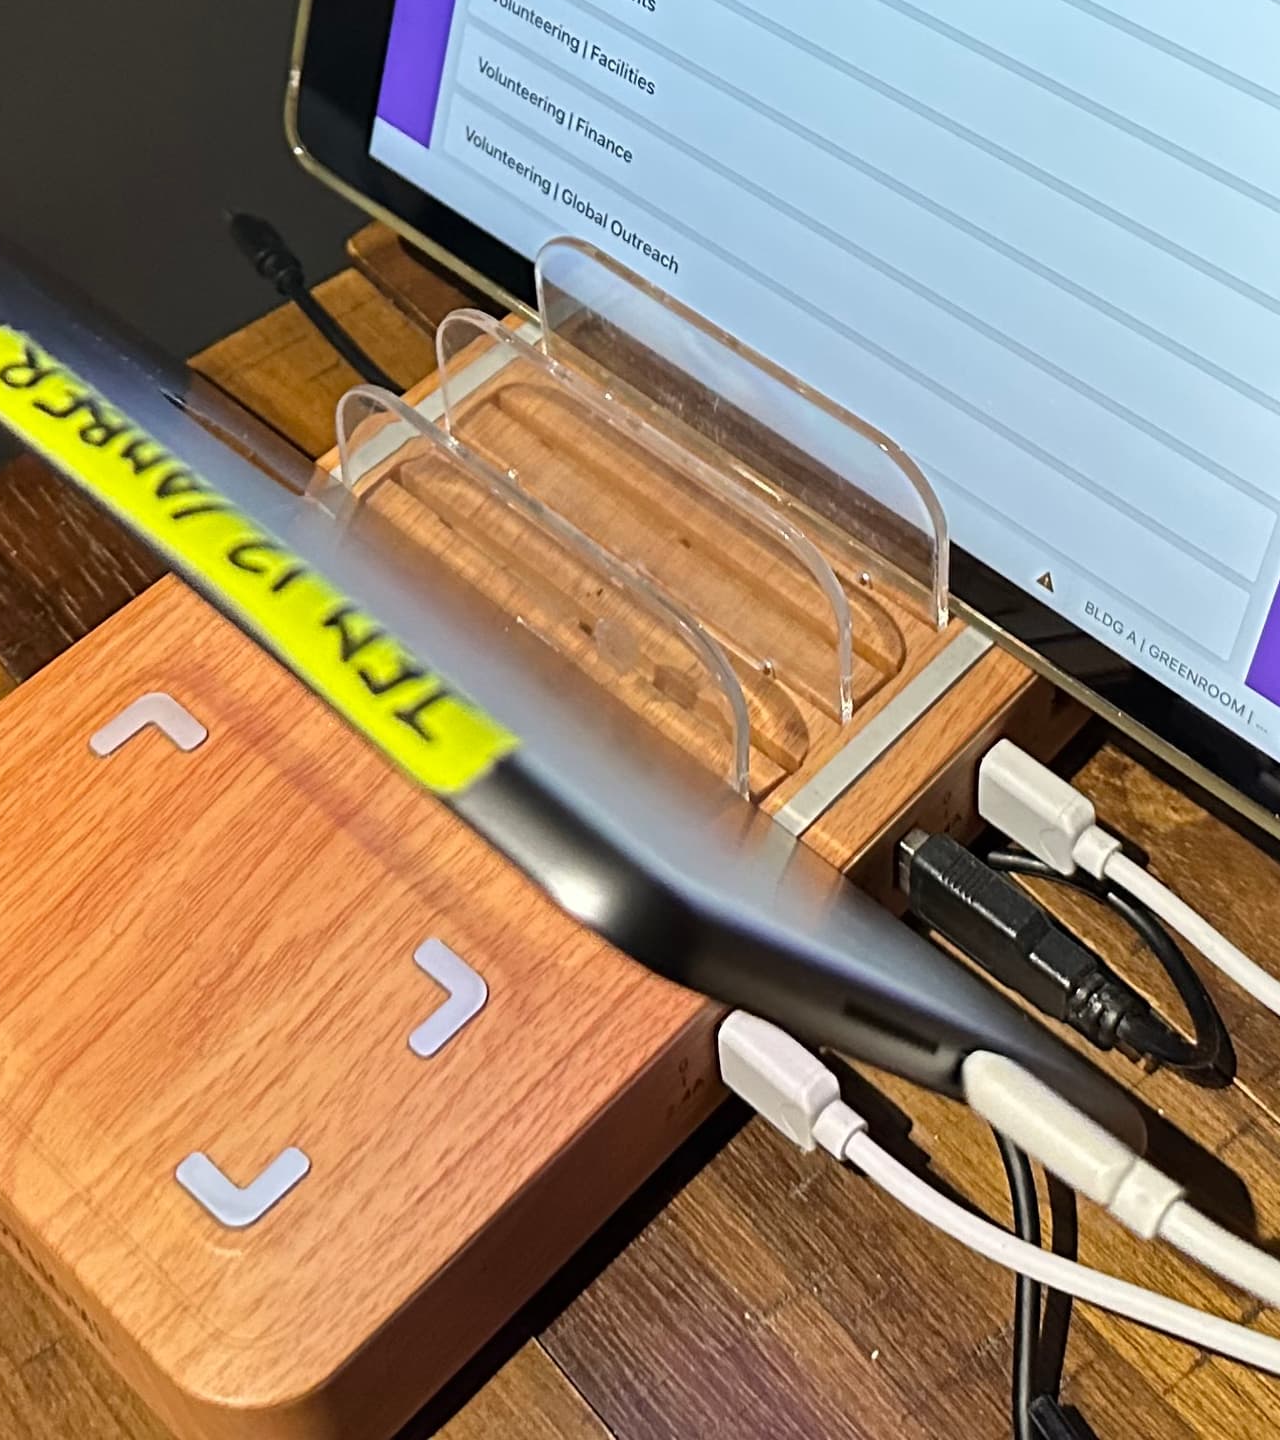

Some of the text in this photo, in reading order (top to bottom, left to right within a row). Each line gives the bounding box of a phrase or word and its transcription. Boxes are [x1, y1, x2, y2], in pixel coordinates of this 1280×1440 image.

[478, 56, 565, 125] Volunteering
[575, 116, 633, 164] Finance
[590, 45, 656, 95] Facilities
[465, 125, 551, 195] Volunteering
[561, 189, 608, 229] Global
[610, 220, 679, 274] Outreach
[1084, 600, 1124, 635] BLDG
[1125, 629, 1137, 647] A
[1149, 642, 1246, 718] GREENROOM
